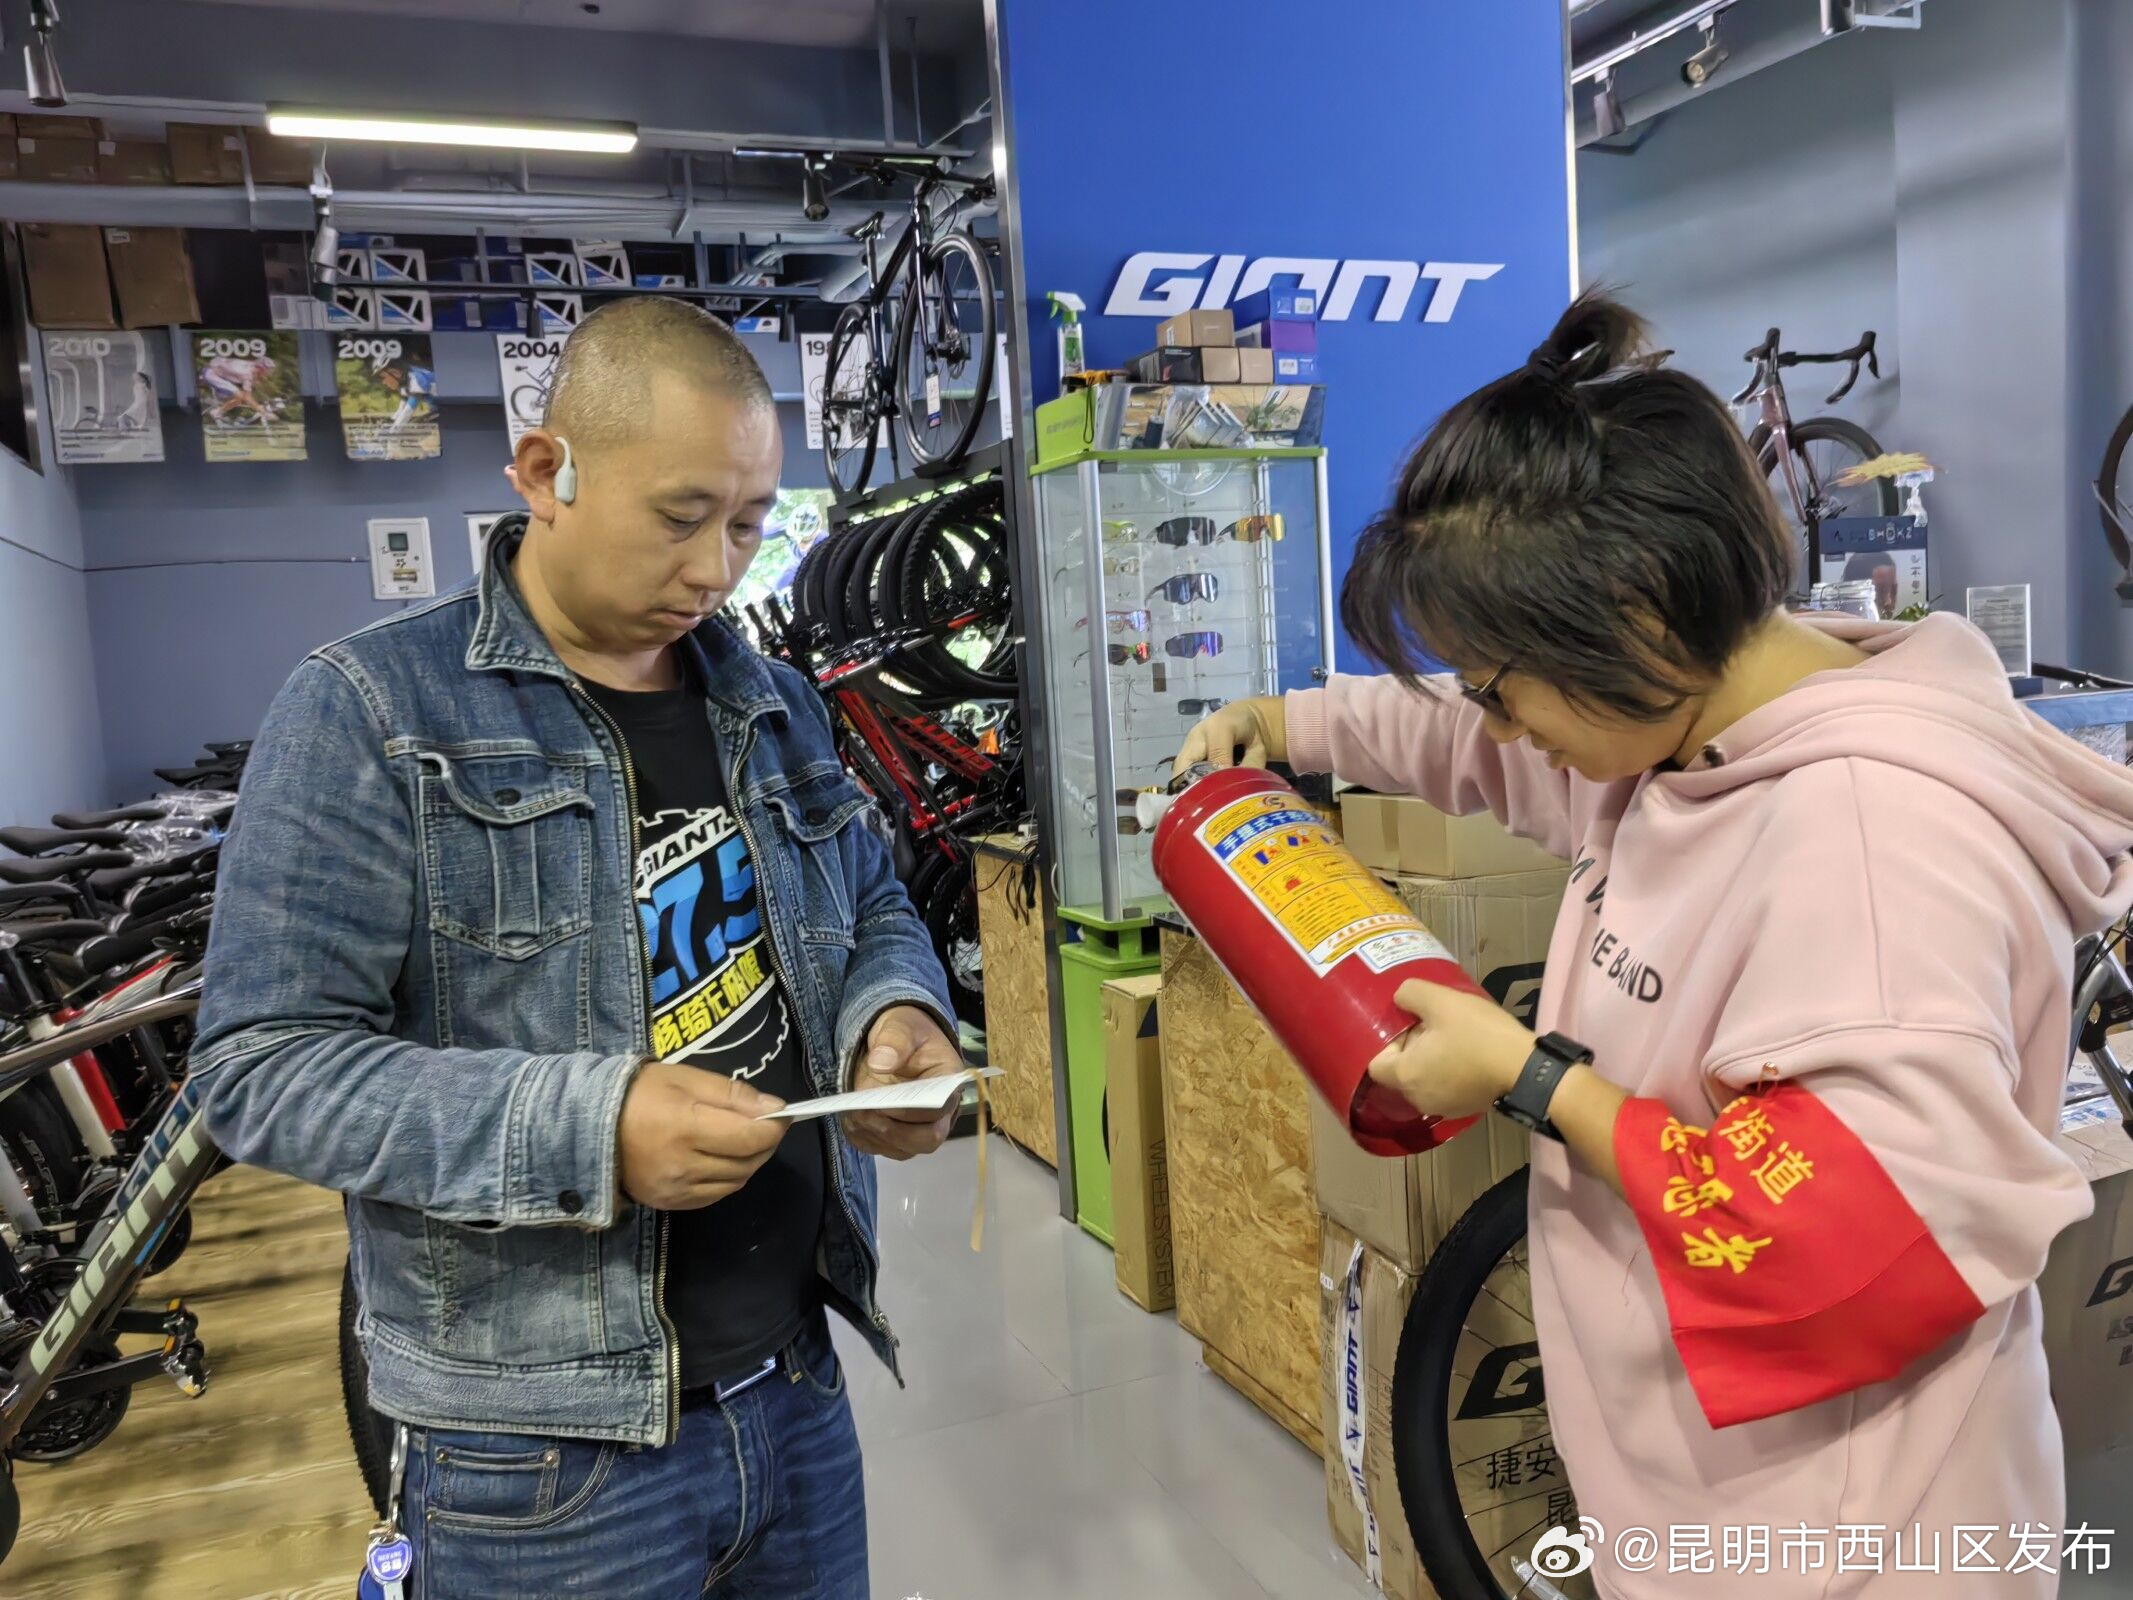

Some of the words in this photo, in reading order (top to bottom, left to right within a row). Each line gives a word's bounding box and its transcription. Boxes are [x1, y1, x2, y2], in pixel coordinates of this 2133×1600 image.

[1104, 252, 1506, 323] GIANT
[49, 338, 110, 357] 2010
[200, 338, 267, 357] 2009
[338, 339, 402, 359] 2009
[504, 341, 560, 359] 2004
[1719, 1096, 1814, 1205] 街道
[30, 1106, 202, 1375] GIANT
[1345, 1328, 1359, 1415] GIANT
